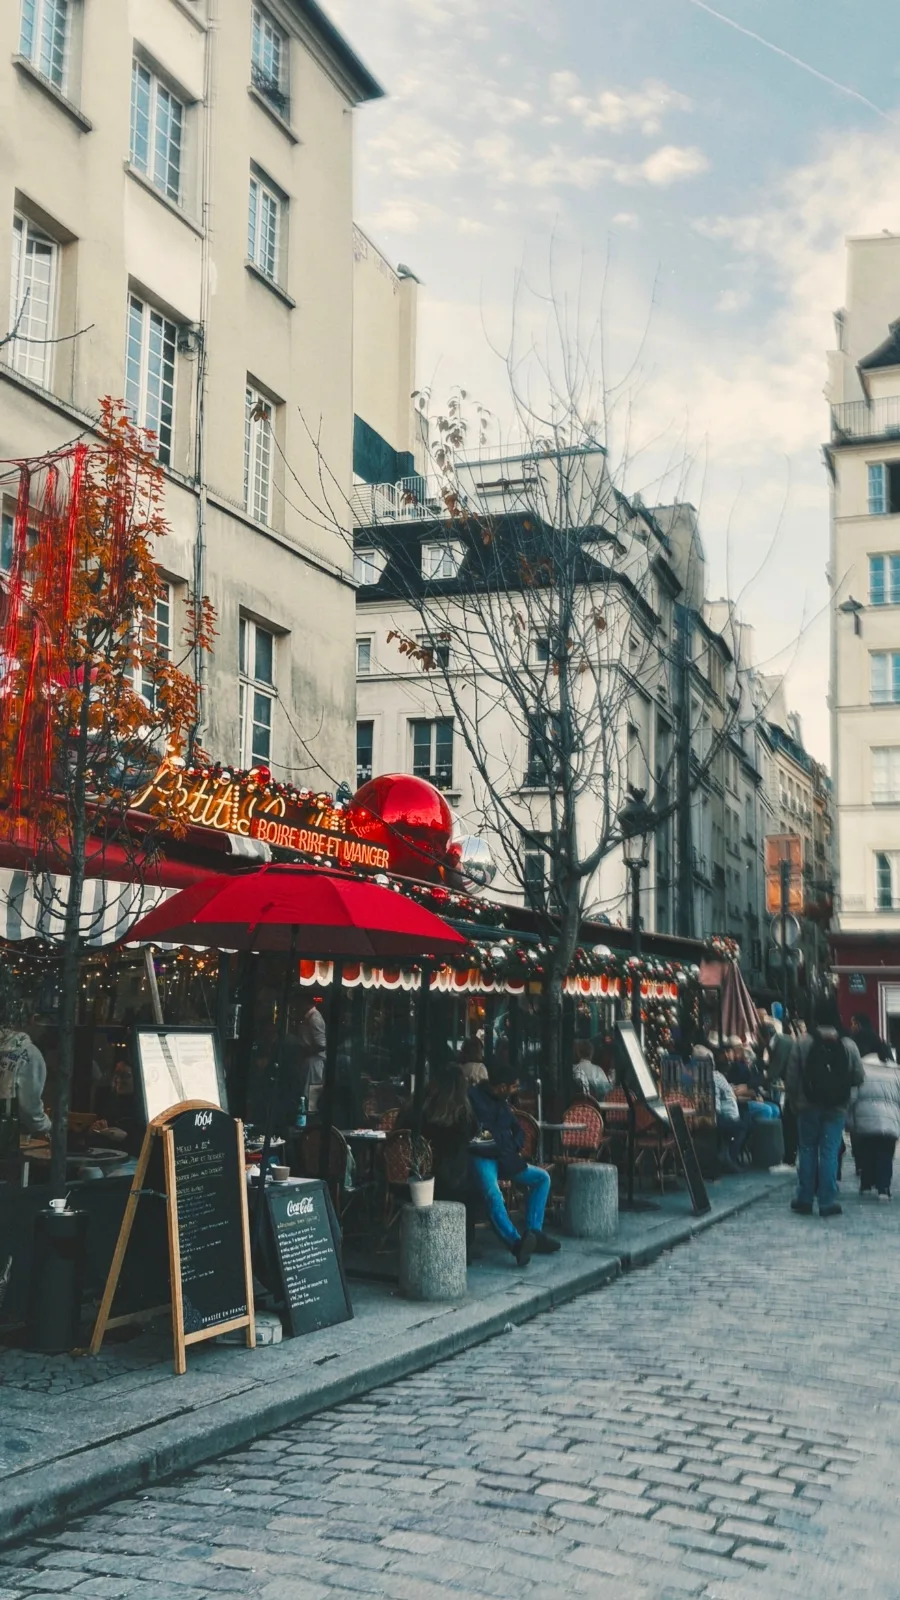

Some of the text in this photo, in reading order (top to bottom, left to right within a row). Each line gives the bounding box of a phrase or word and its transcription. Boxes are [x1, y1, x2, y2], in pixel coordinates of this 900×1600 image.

[257, 818, 299, 849] BOIRE
[298, 829, 327, 855] RIRE
[326, 836, 342, 858] ET
[343, 840, 390, 869] MANGER
[194, 1110, 213, 1127] 1664
[286, 1196, 314, 1217] Coca-Cola
[222, 1310, 229, 1318] EN
